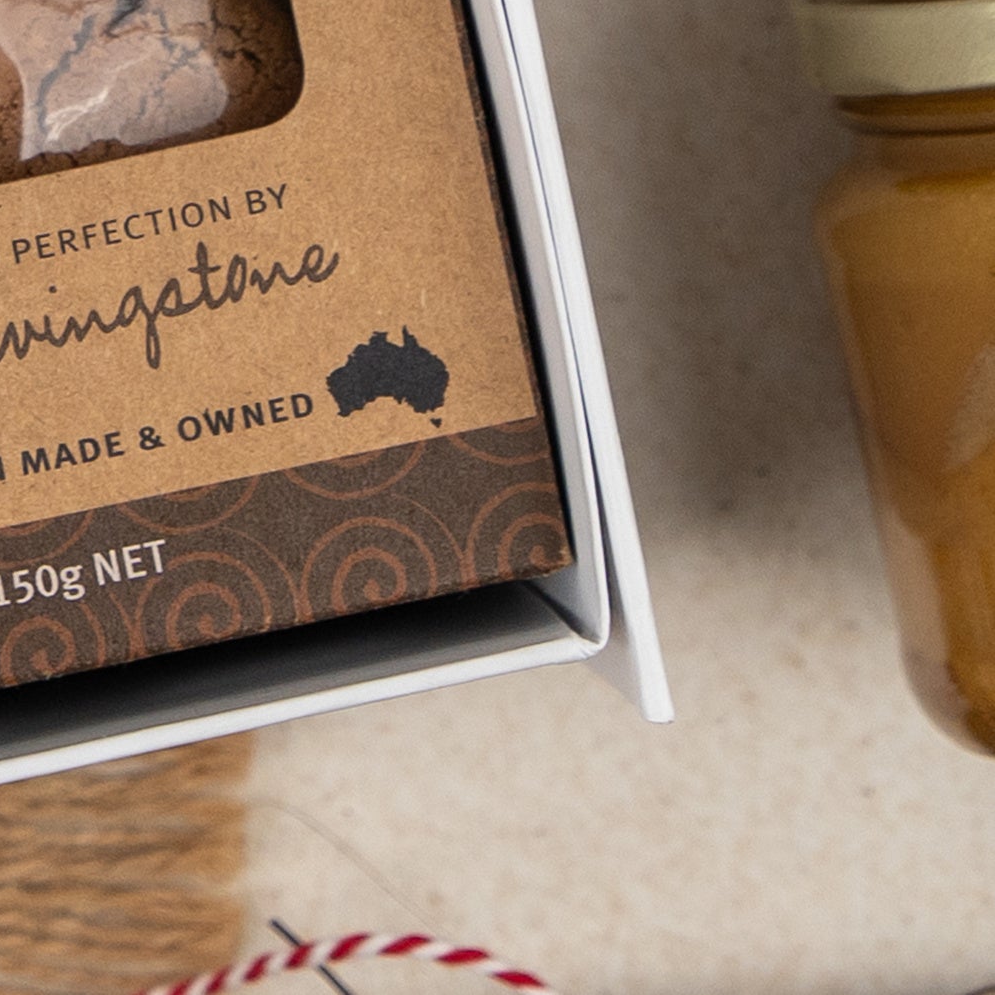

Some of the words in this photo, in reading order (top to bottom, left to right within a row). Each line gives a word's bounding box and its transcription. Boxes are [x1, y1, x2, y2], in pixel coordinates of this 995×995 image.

[12, 196, 232, 264] PERFECTION
[245, 184, 288, 215] BY
[21, 431, 125, 476] MADE
[139, 426, 166, 450] &
[178, 393, 314, 442] OWNED
[92, 539, 166, 586] NET
